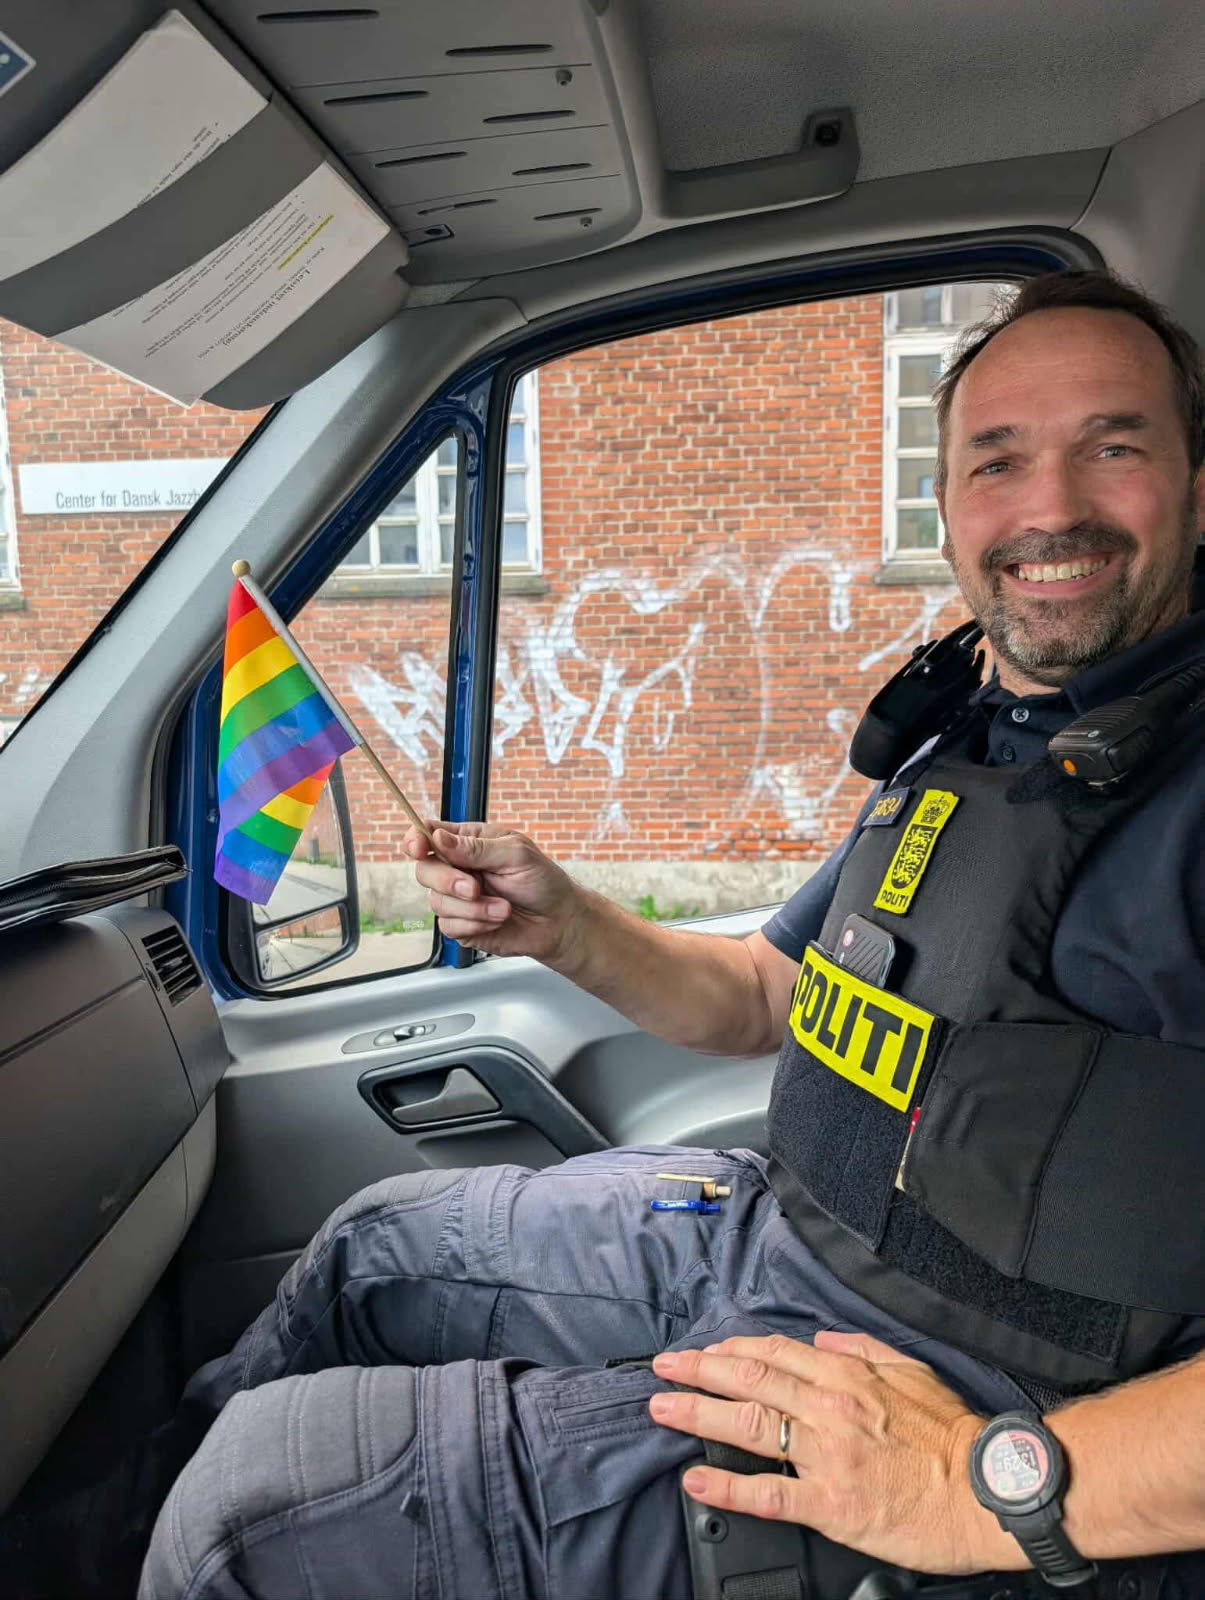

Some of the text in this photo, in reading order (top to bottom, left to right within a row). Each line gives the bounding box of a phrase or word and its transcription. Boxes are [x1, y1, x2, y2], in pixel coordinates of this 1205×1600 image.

[56, 491, 96, 508] Center
[101, 490, 117, 507] for
[122, 489, 161, 507] Dansk
[880, 890, 910, 908] POLITI
[791, 961, 925, 1095] POLITI
